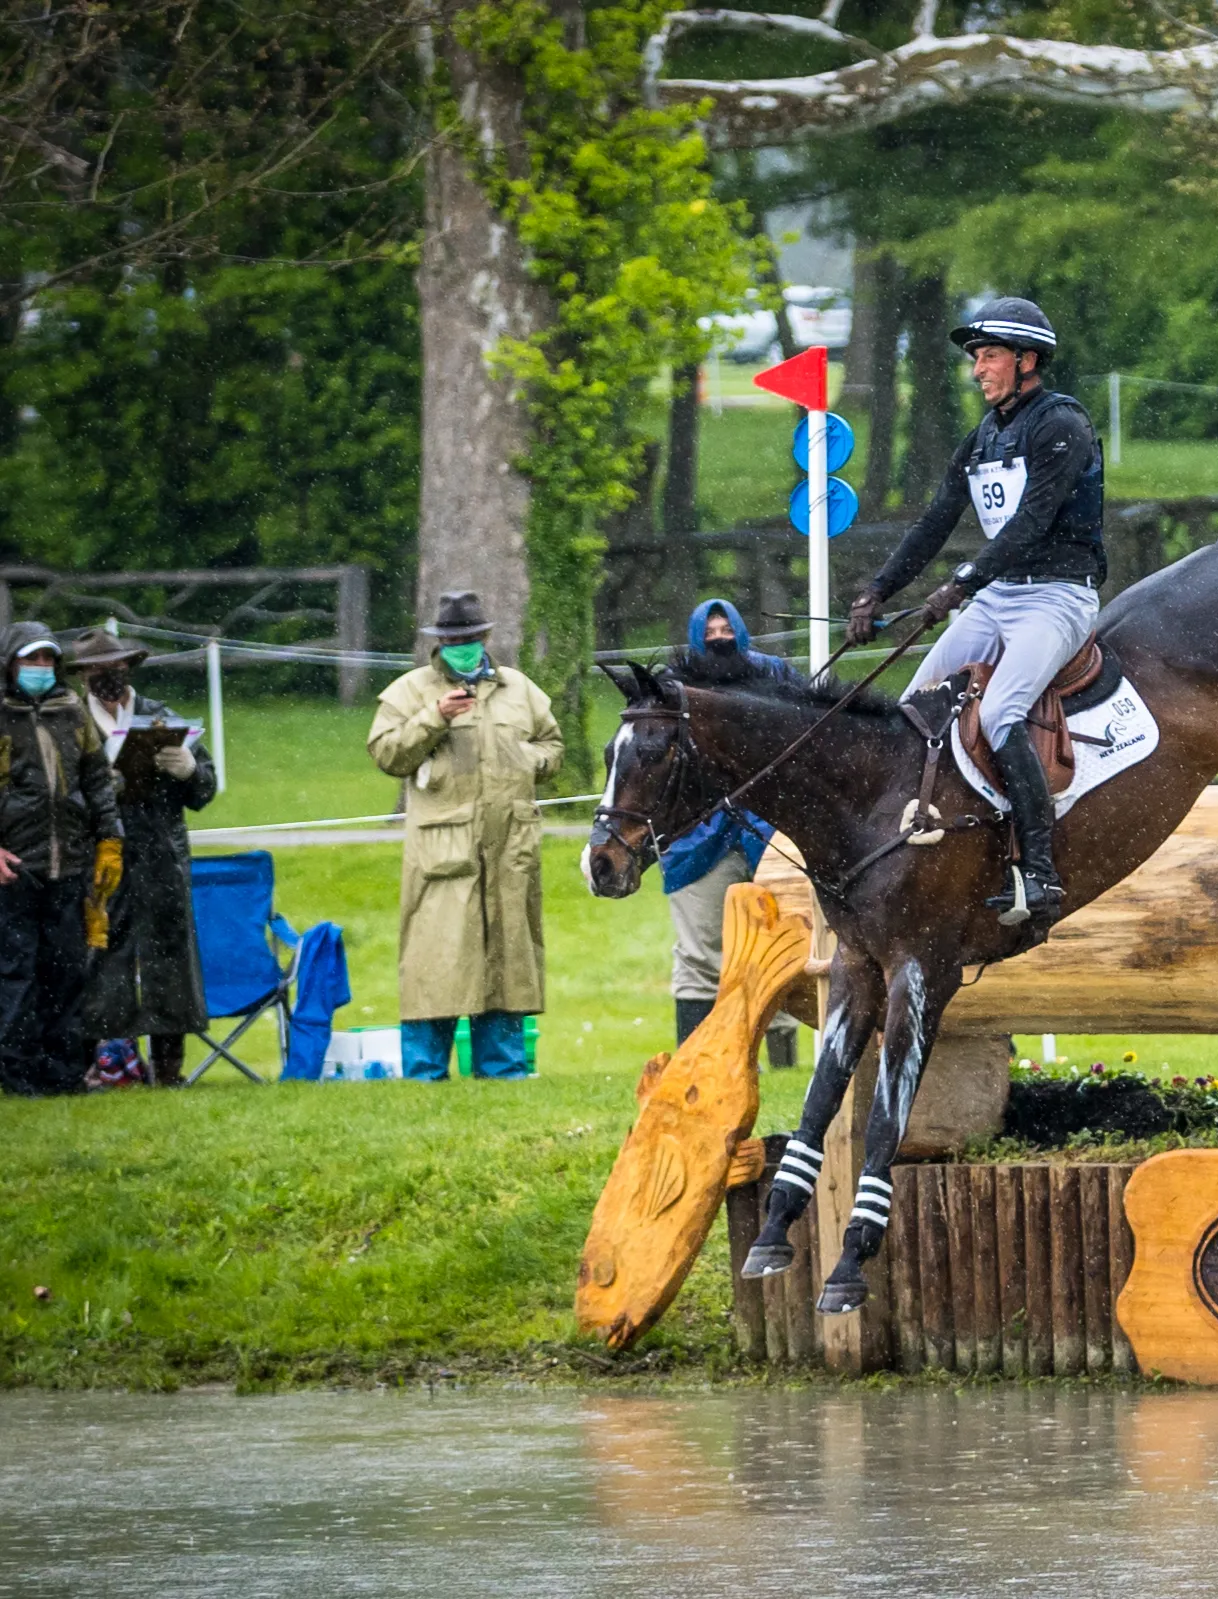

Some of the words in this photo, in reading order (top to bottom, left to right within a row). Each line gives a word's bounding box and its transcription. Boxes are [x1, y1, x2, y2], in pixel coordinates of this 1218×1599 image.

[982, 482, 1005, 510] 59
[1112, 697, 1136, 716] 059
[1099, 747, 1115, 759] NEW
[1115, 734, 1146, 752] ZEALAND
